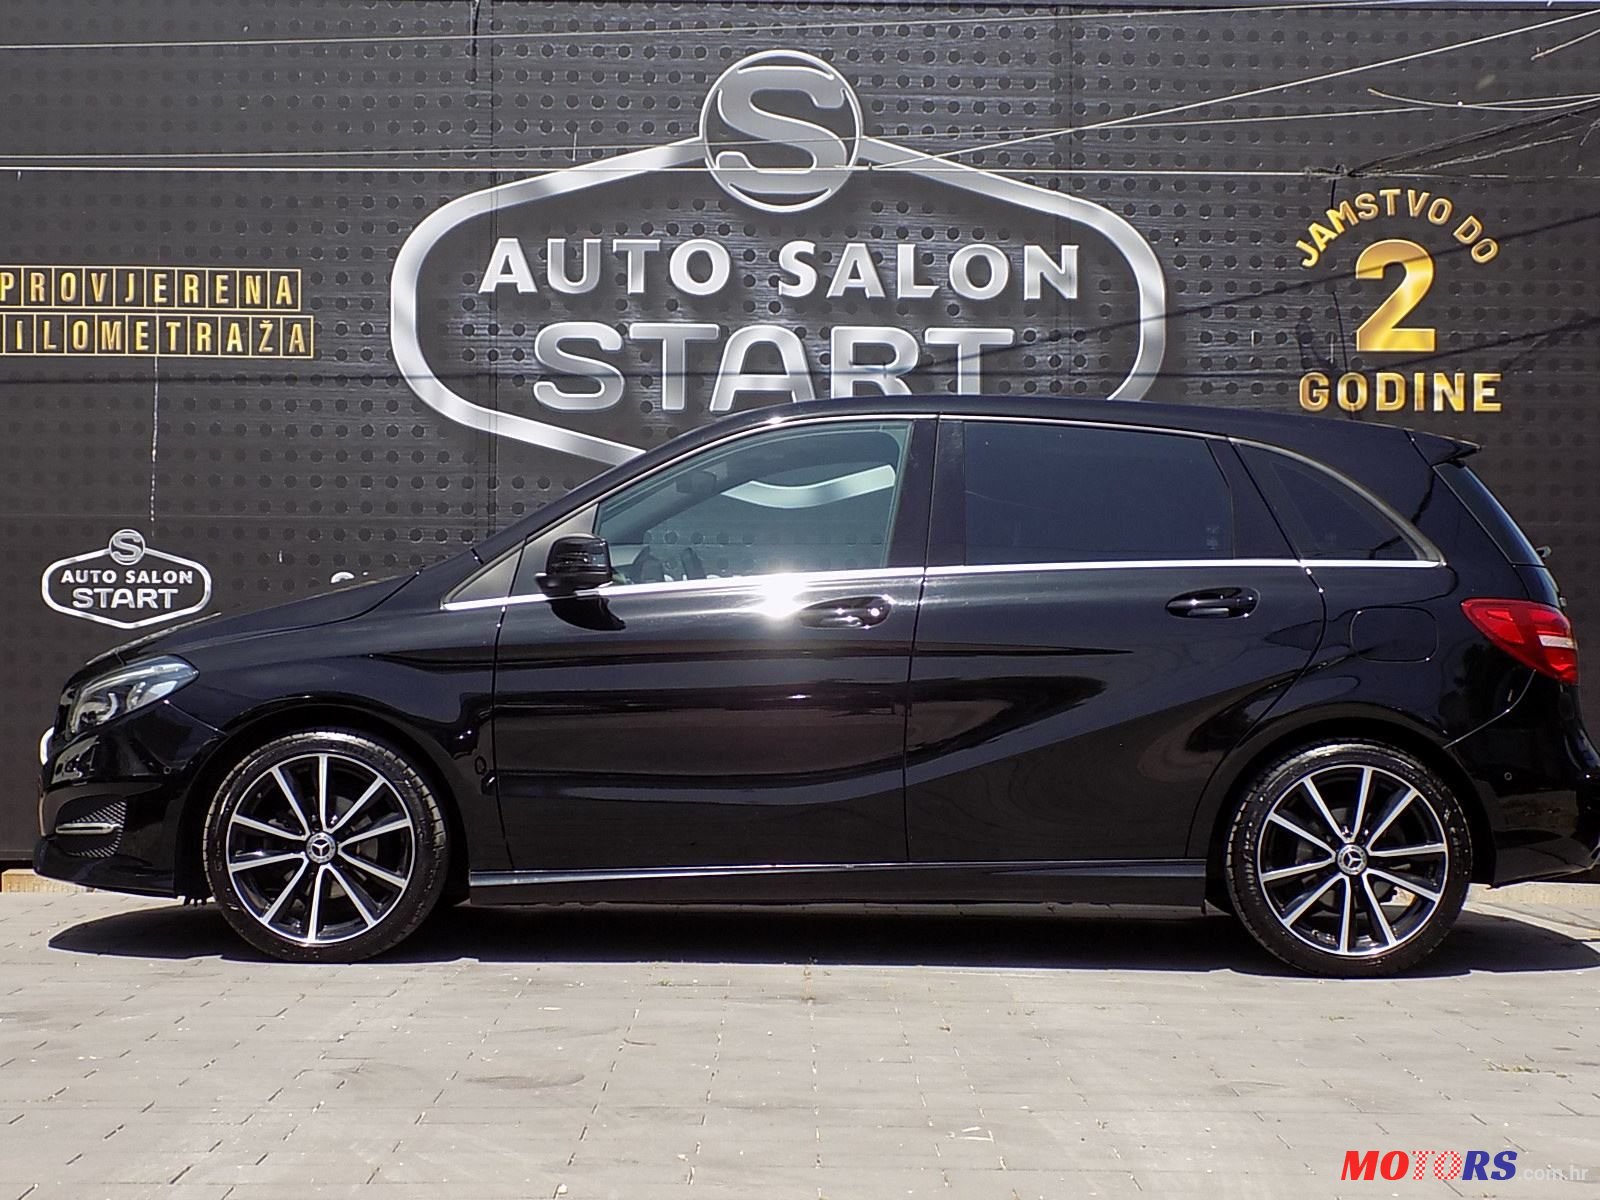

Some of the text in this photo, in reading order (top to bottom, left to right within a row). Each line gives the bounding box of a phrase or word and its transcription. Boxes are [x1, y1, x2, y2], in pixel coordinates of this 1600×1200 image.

[713, 64, 850, 195] S
[1295, 188, 1499, 268] JAMSTVO DO
[0, 271, 293, 305] PROVJERENA
[478, 237, 1080, 300] AUTO SALON
[1355, 238, 1436, 352] 2
[14, 319, 307, 353] ILOMETRAŽA
[533, 321, 1015, 412] START
[1298, 371, 1502, 412] GODINE
[111, 532, 143, 562] S
[60, 569, 193, 585] AUTO SALON
[72, 587, 179, 609] START
